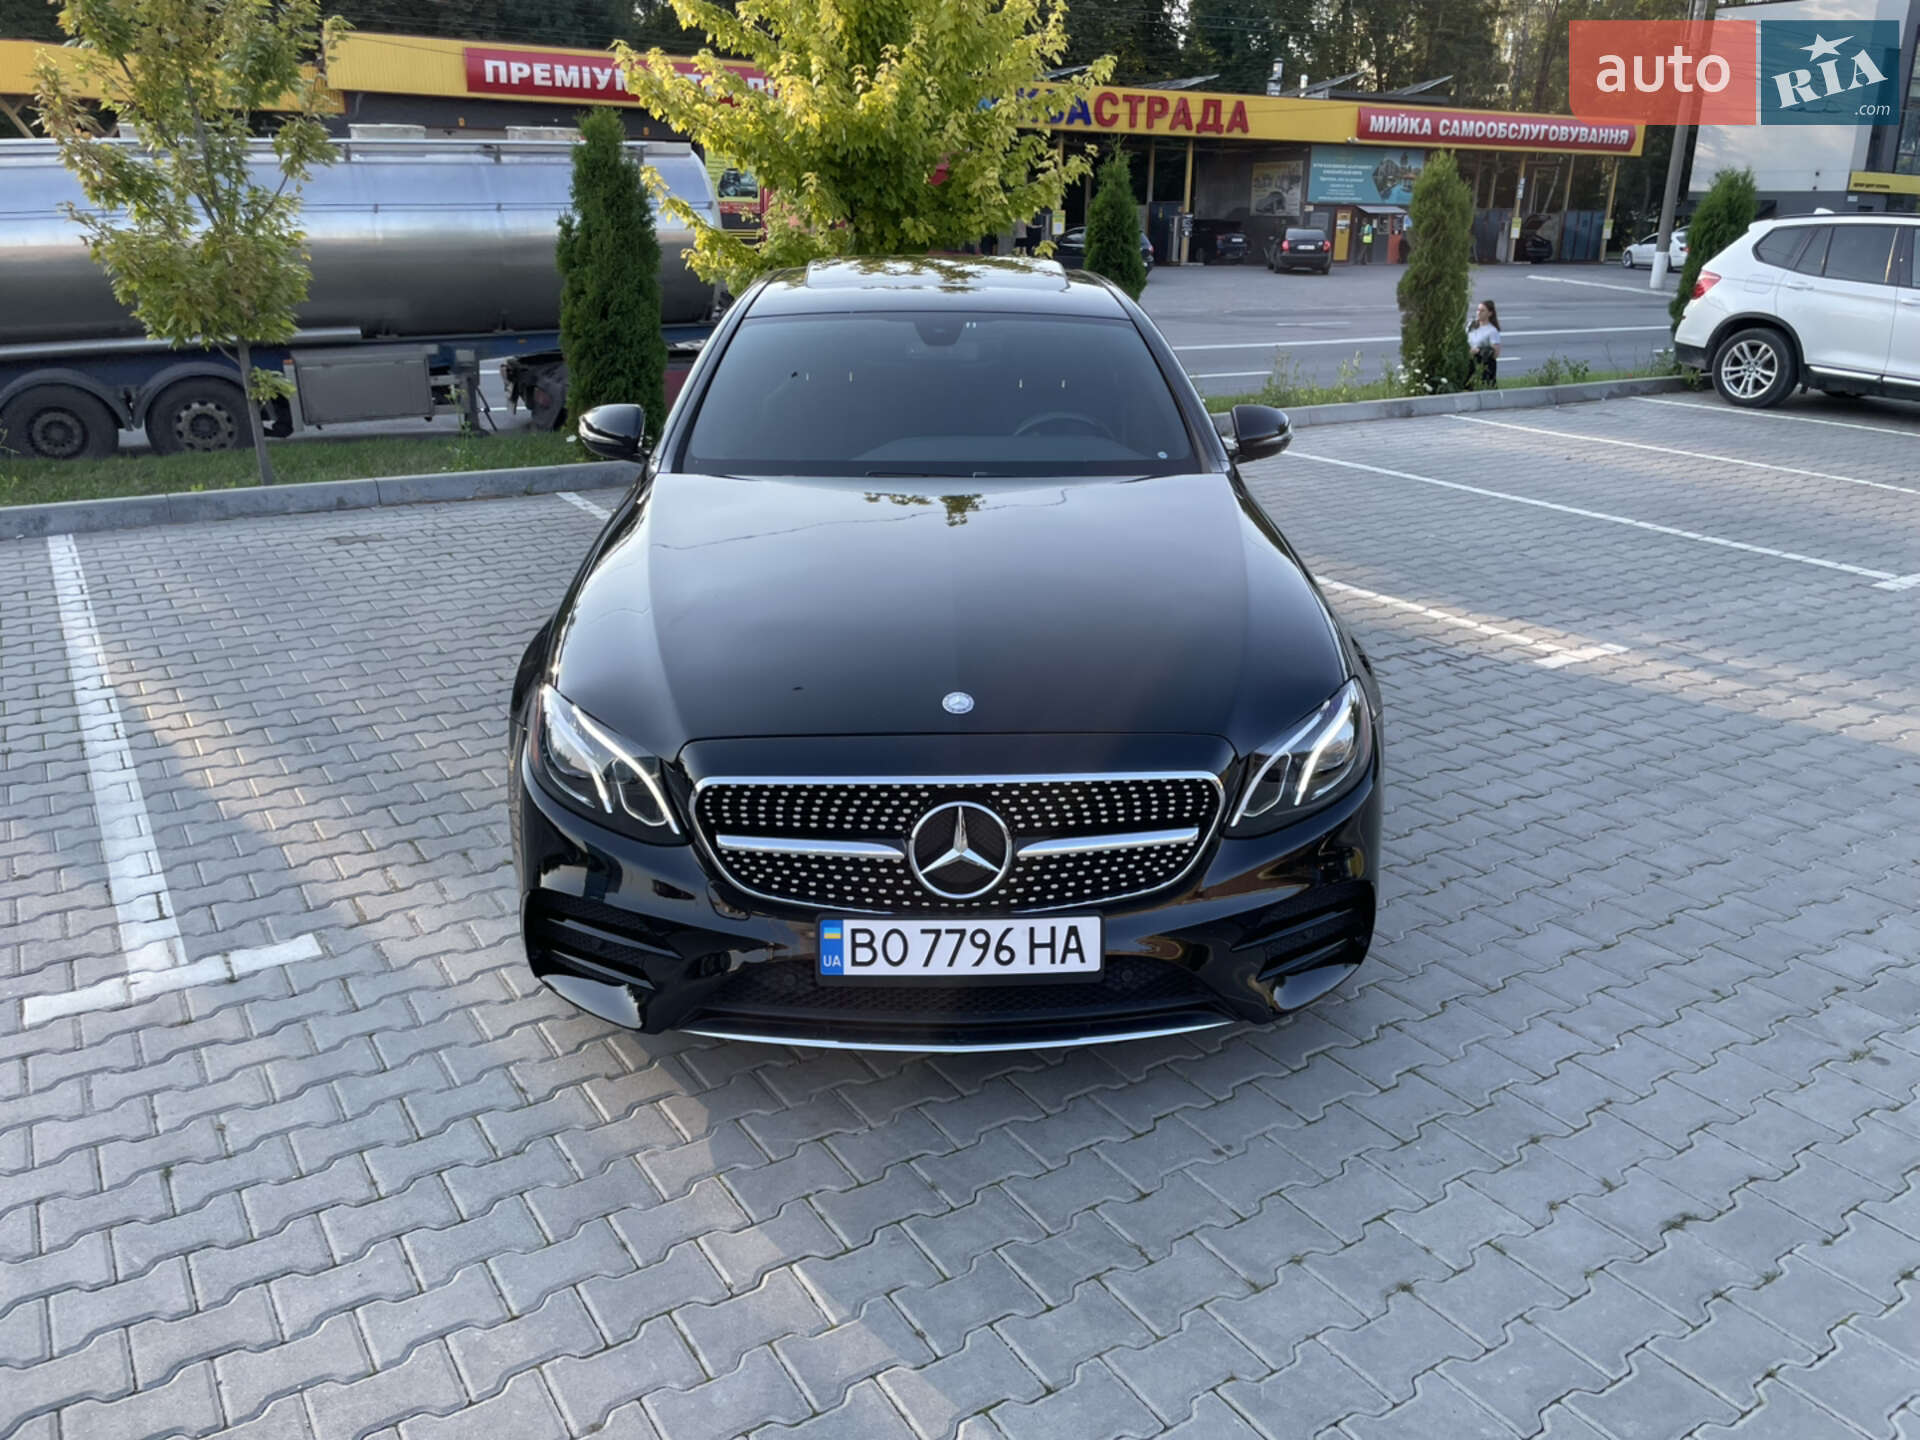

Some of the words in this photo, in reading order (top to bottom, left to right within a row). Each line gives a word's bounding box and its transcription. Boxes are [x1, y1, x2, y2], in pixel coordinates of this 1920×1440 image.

[1369, 113, 1432, 136] МИЙКА
[1438, 119, 1630, 145] САМООБСЛУГОВУВАННЯ
[823, 954, 841, 968] UA
[850, 927, 909, 967] BO
[920, 927, 1015, 967] 7796
[1029, 925, 1086, 965] HA
